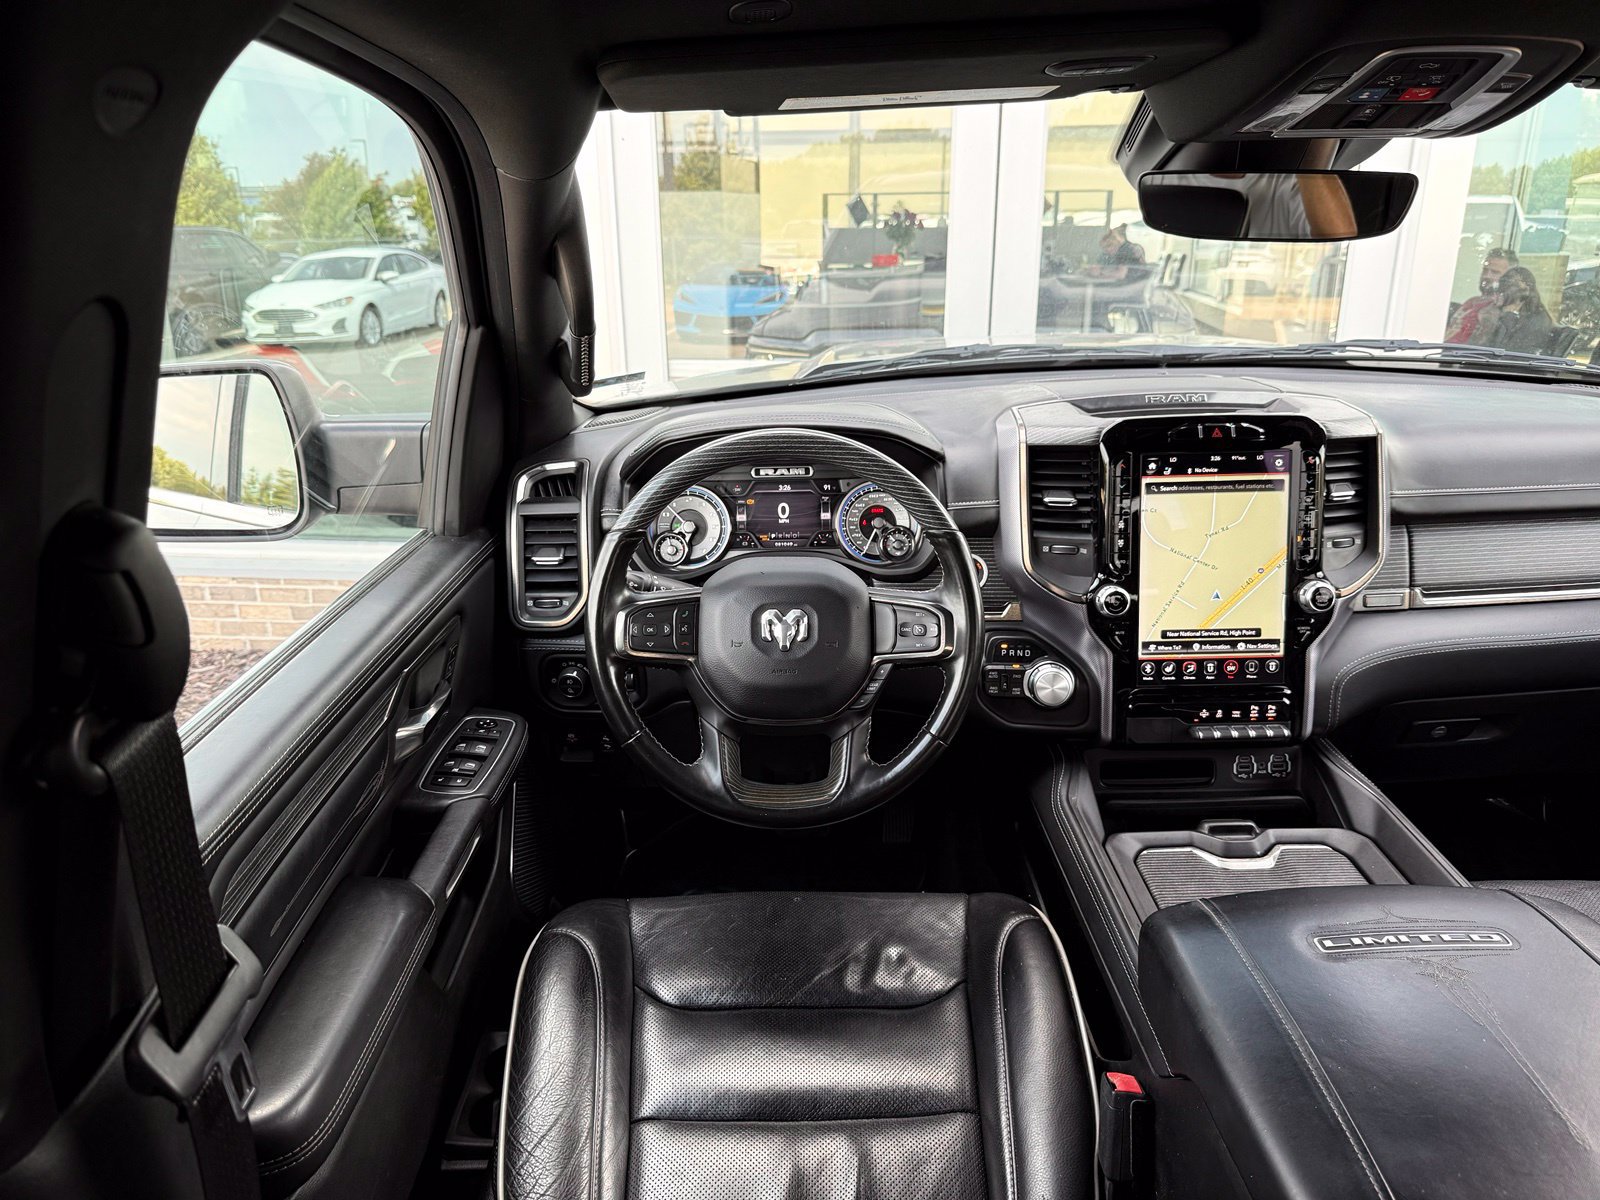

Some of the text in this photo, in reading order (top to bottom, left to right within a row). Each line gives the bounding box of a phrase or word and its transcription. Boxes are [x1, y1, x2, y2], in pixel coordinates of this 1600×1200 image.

[1145, 394, 1207, 403] RAM
[777, 502, 790, 519] 0
[1322, 933, 1503, 947] LIMITED
